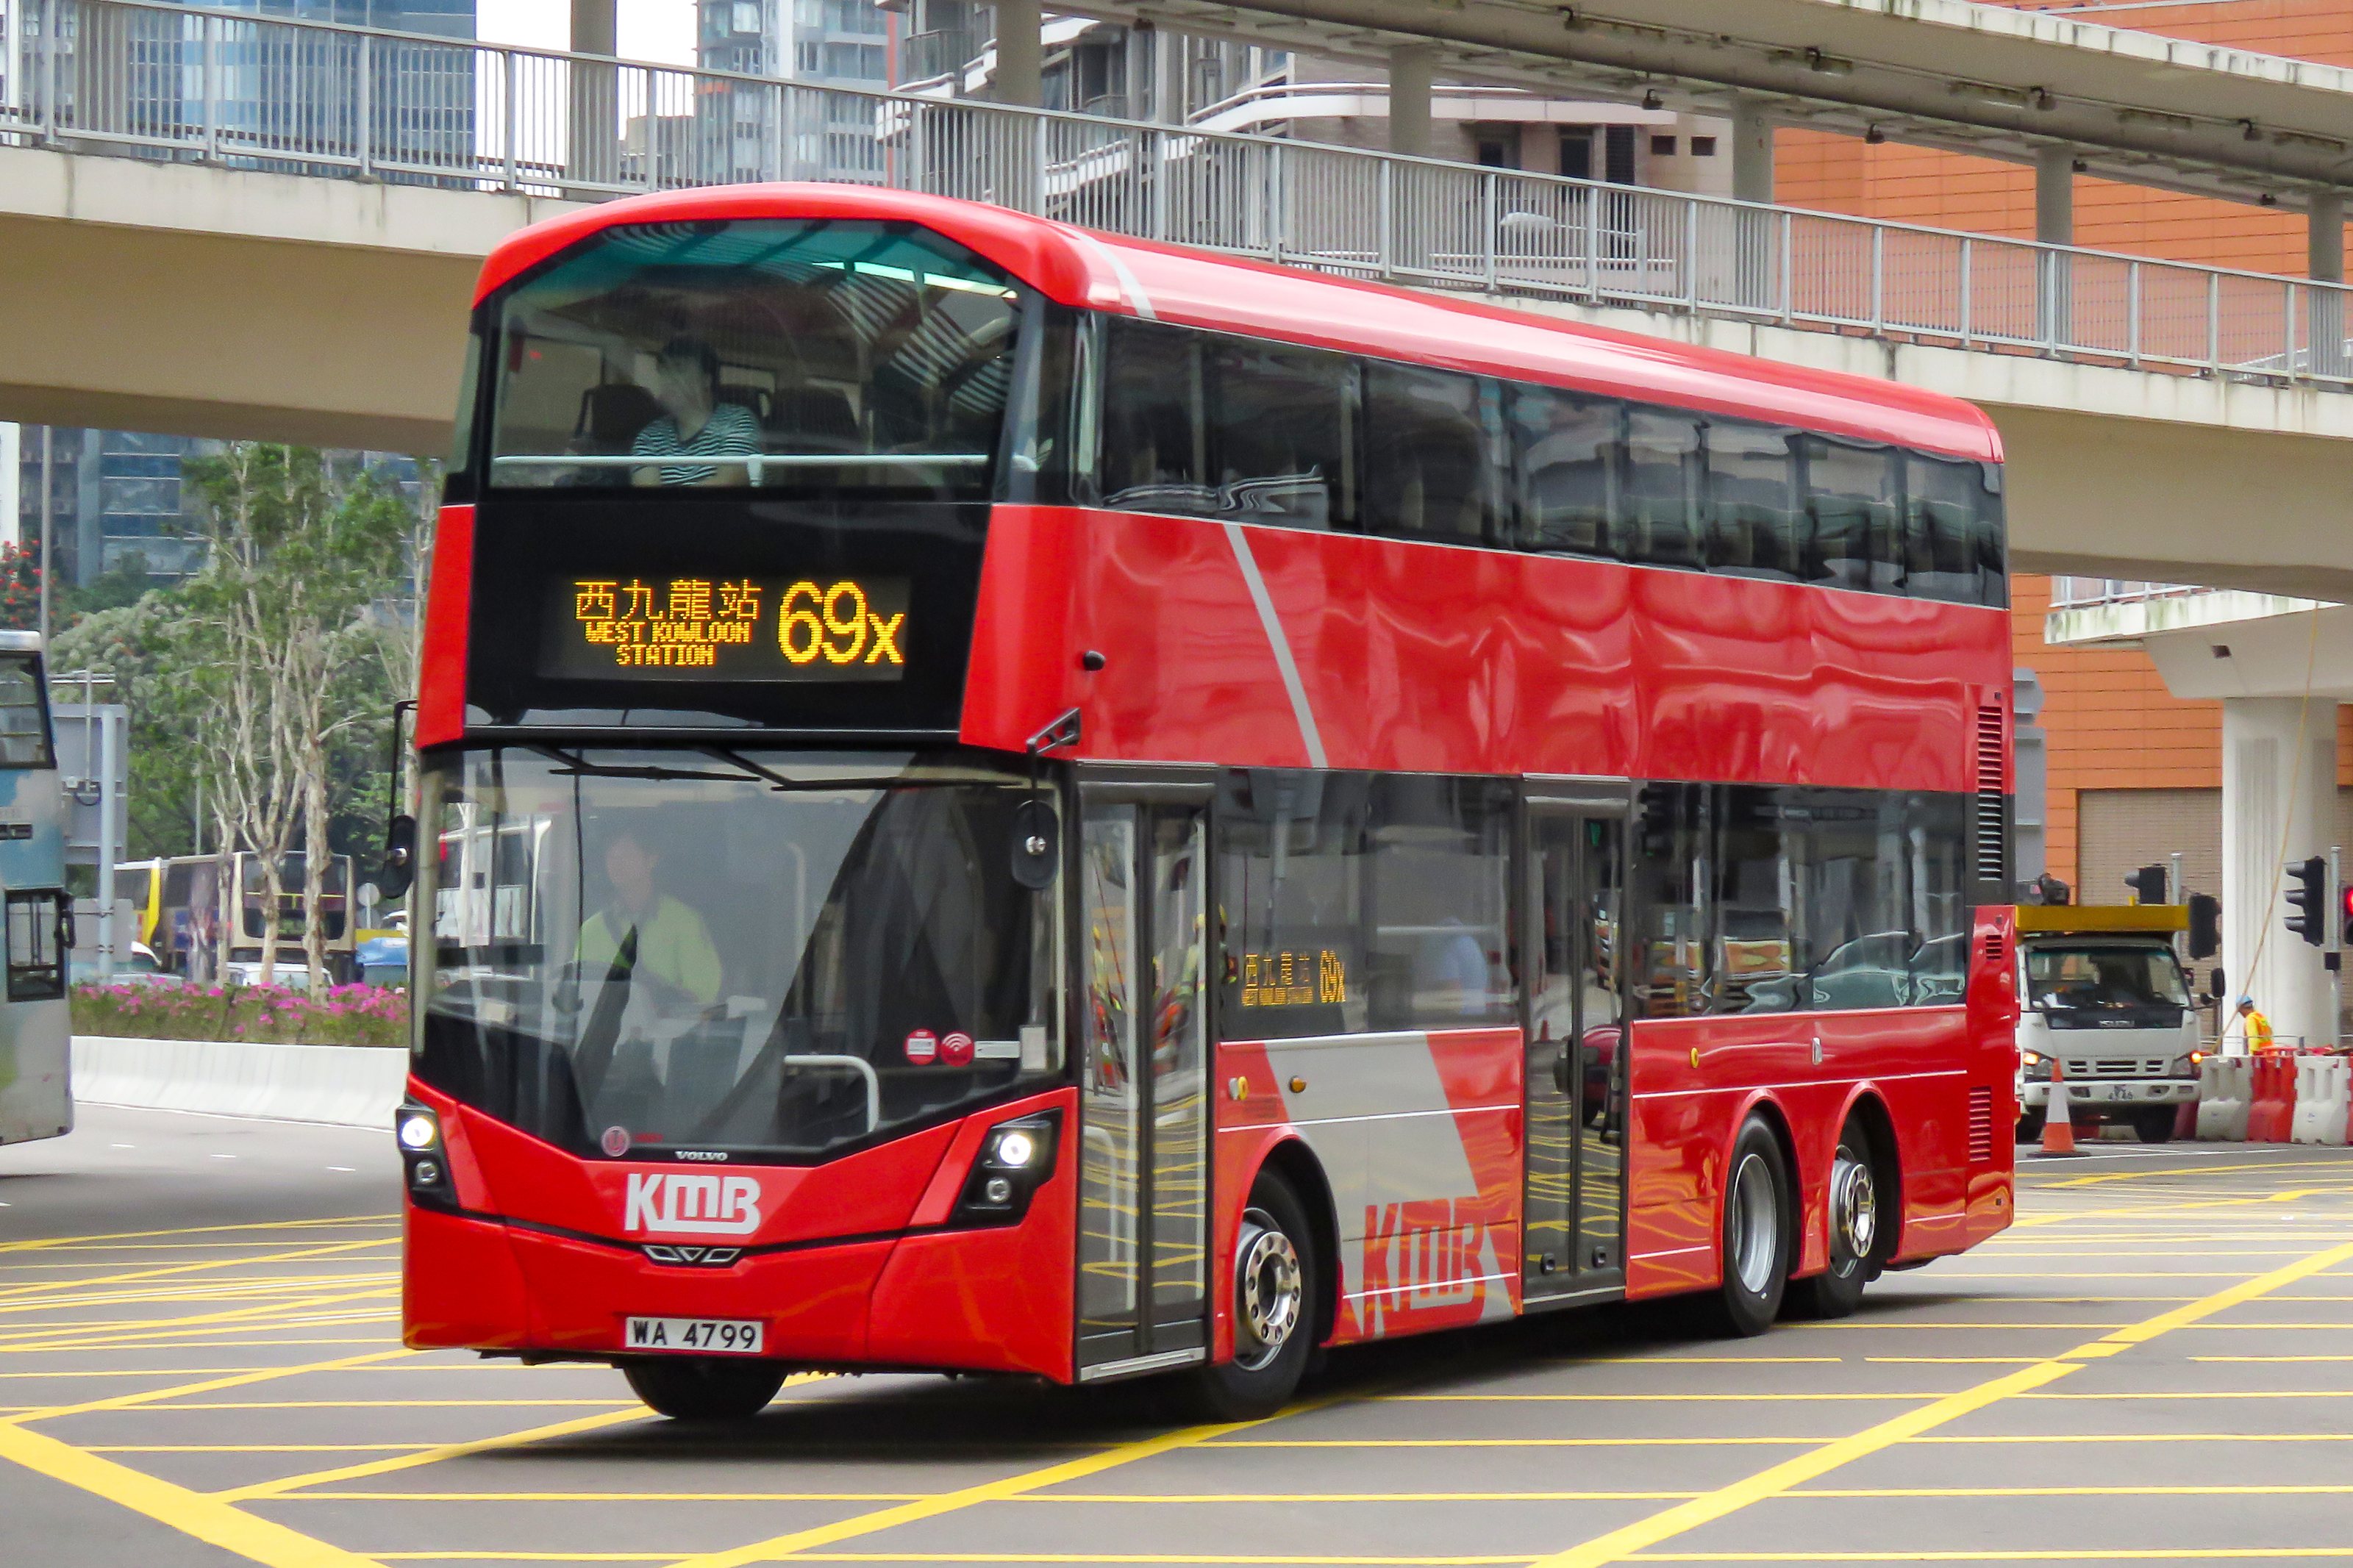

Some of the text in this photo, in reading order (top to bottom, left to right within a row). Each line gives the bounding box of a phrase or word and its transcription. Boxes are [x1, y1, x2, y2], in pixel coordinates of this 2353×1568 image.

[574, 579, 763, 620] 西九龍站
[585, 621, 751, 643] WEST KOWLOON
[616, 644, 714, 666] STATION
[675, 1151, 729, 1161] VOLVO
[624, 1173, 762, 1235] KMB
[632, 1320, 757, 1349] WA 4799
